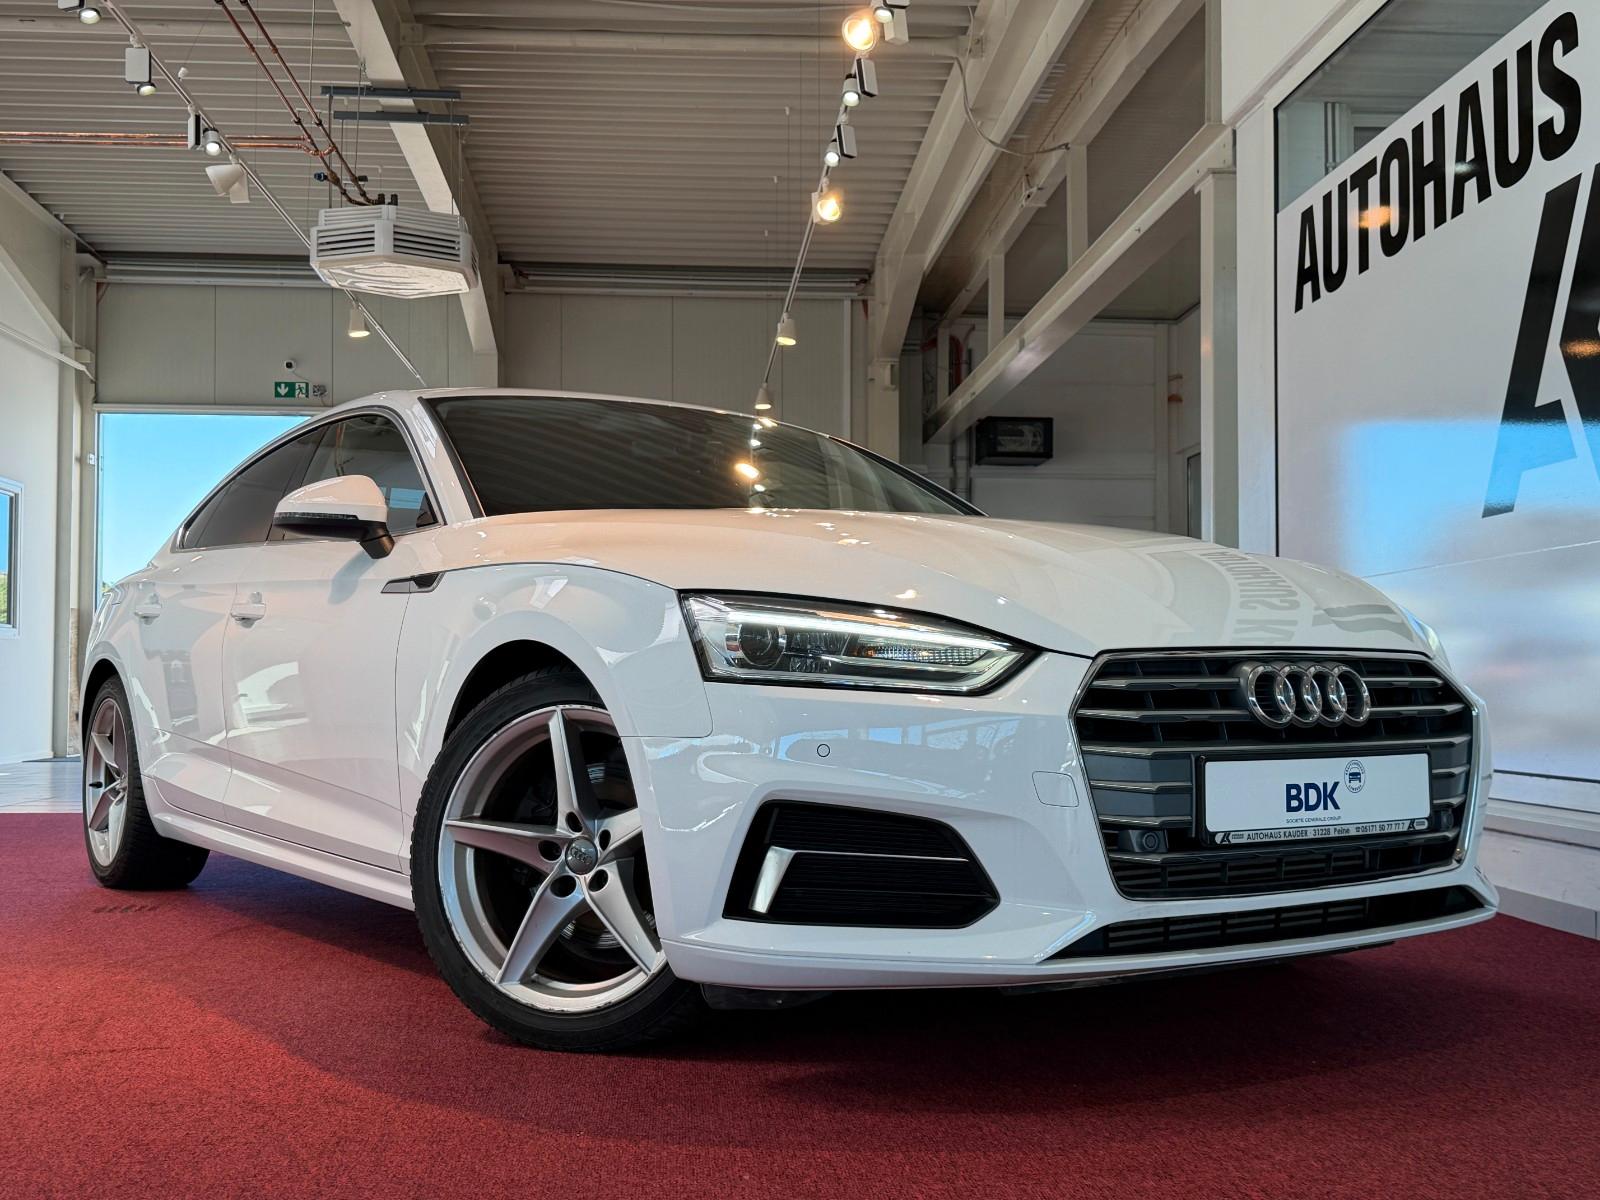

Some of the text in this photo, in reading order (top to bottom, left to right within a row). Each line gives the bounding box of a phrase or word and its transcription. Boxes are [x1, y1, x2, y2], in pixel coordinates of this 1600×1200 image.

[1294, 11, 1582, 314] AUTOHAUS
[1285, 781, 1341, 812] BDK
[1246, 830, 1282, 841] AUTOHAUS
[1283, 829, 1308, 839] KAUDER
[1312, 827, 1331, 837] 31228
[1333, 826, 1350, 835] Peine
